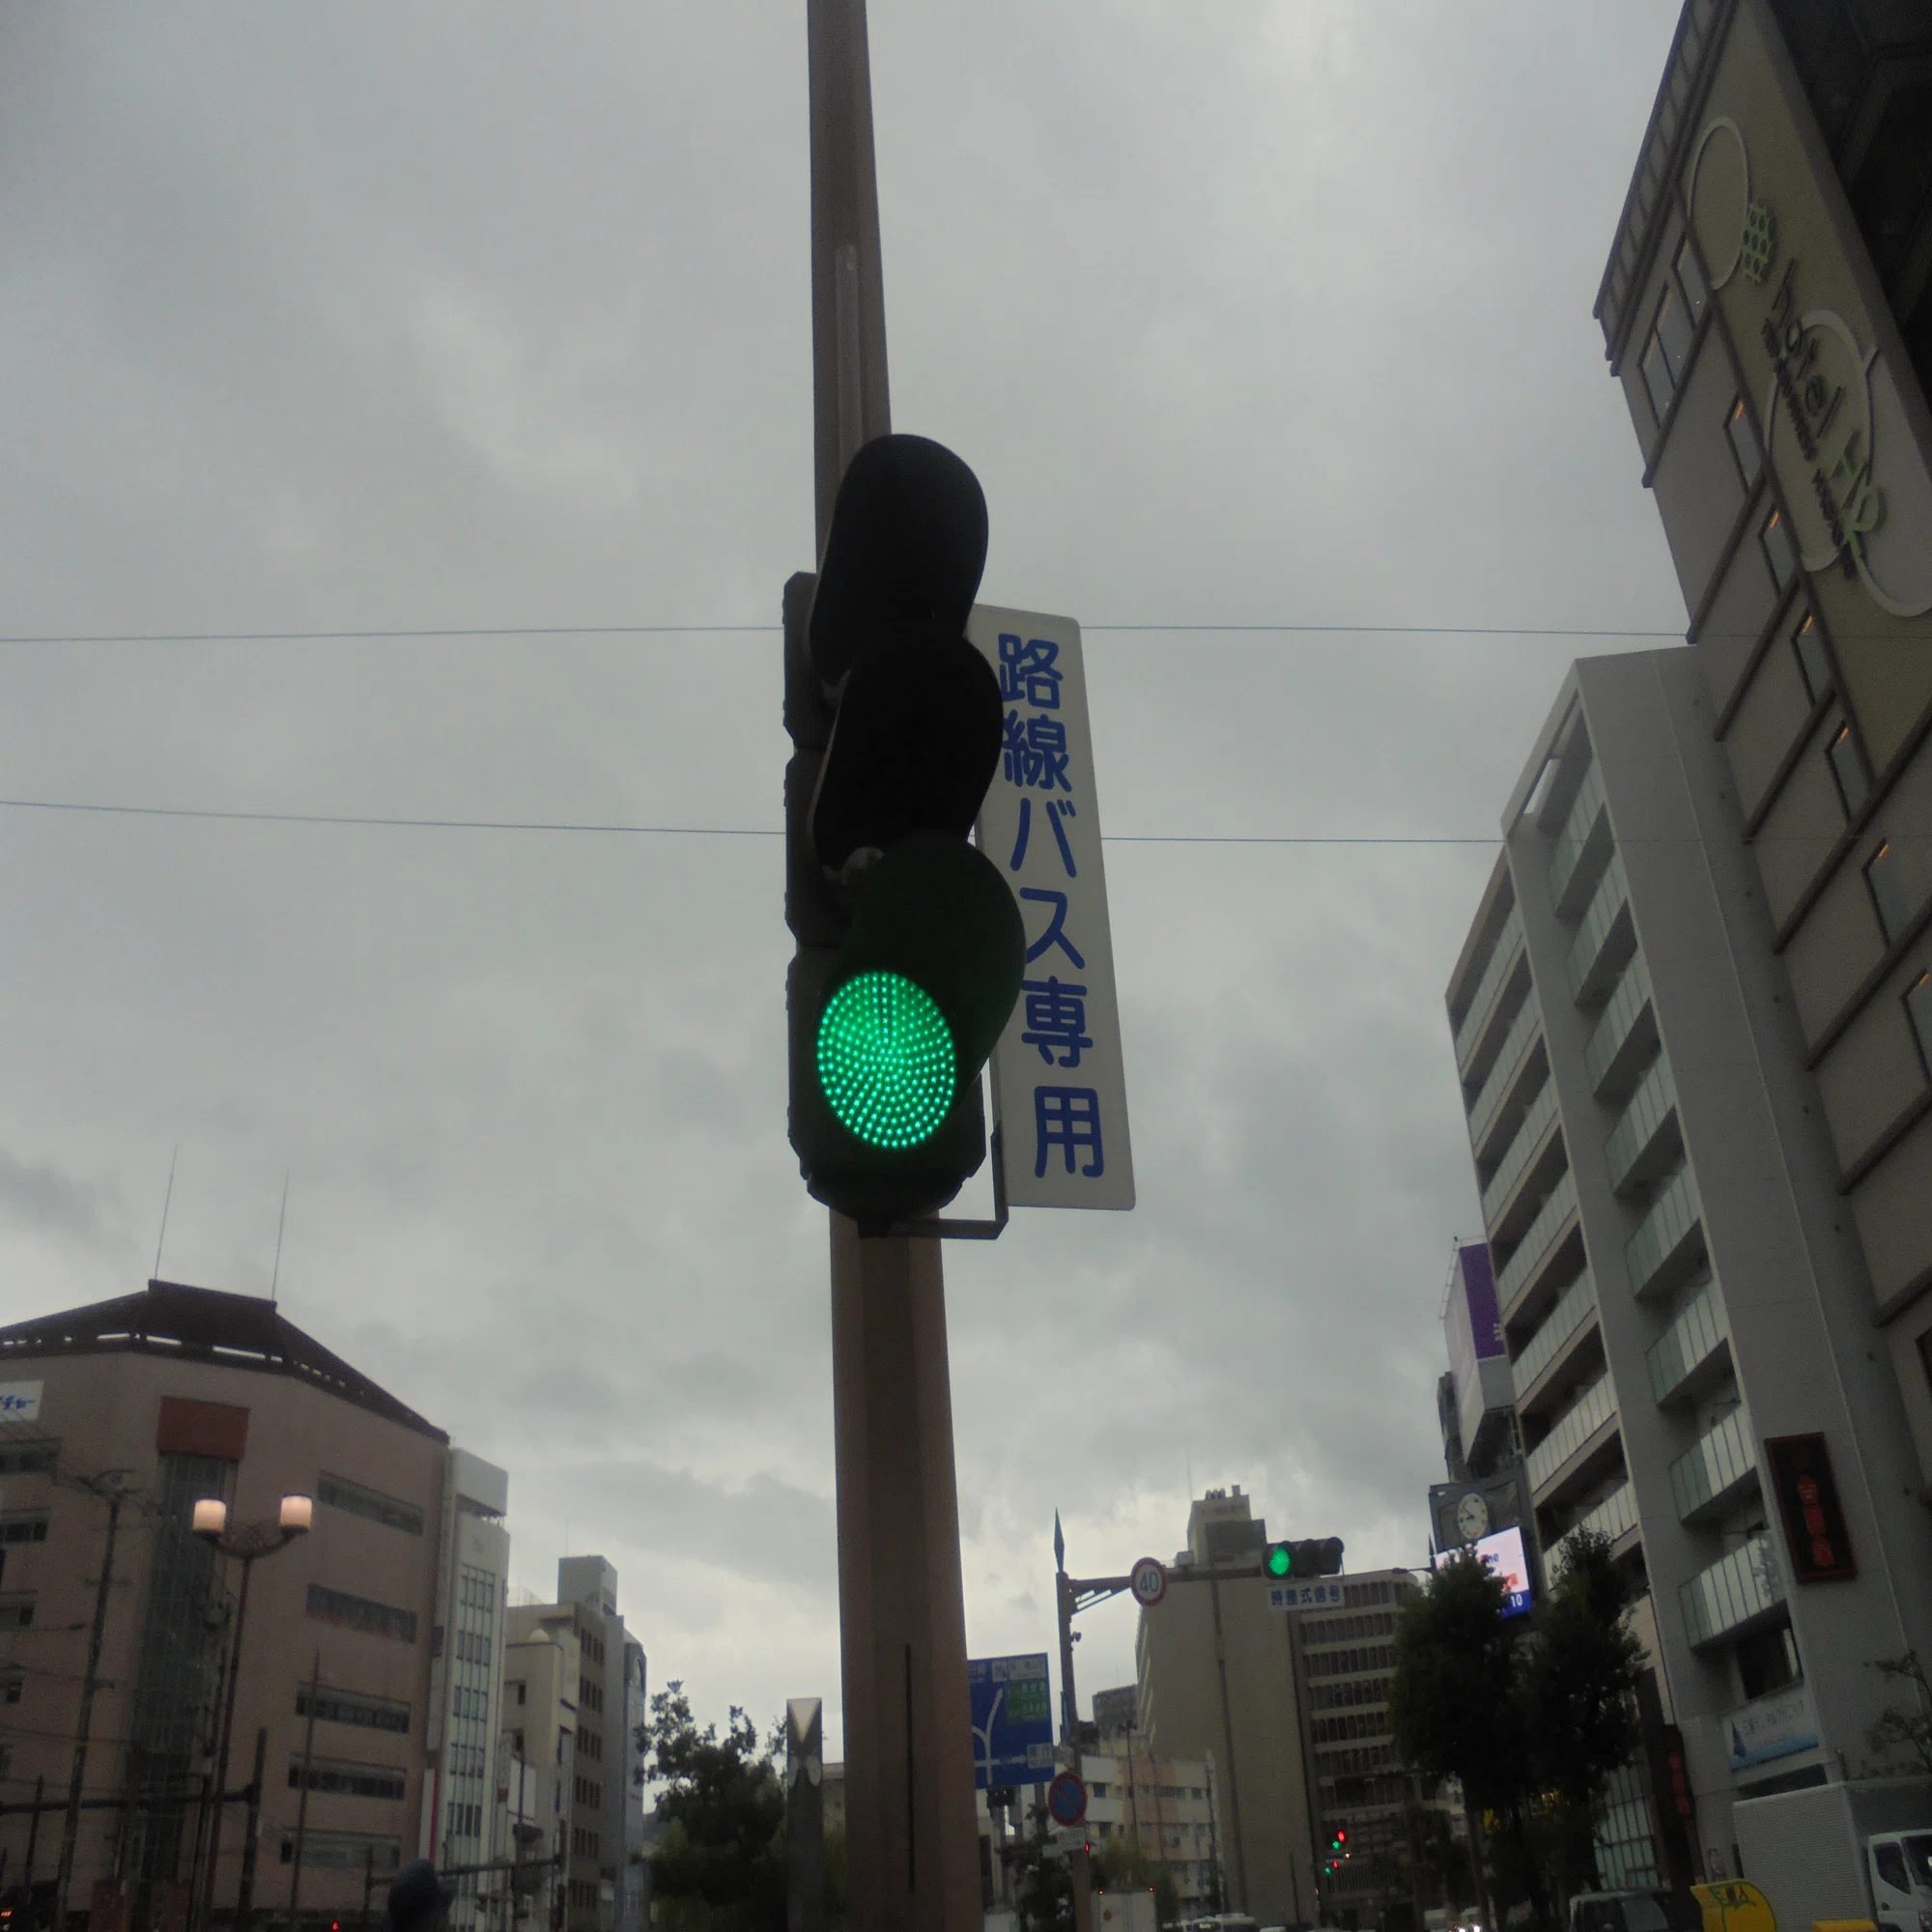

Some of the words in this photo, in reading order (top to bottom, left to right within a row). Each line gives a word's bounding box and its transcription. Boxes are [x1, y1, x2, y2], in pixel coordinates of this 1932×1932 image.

[998, 632, 1103, 1178] 路線バス専用
[1140, 1572, 1159, 1592] 40
[1270, 1584, 1341, 1606] 時差式信号
